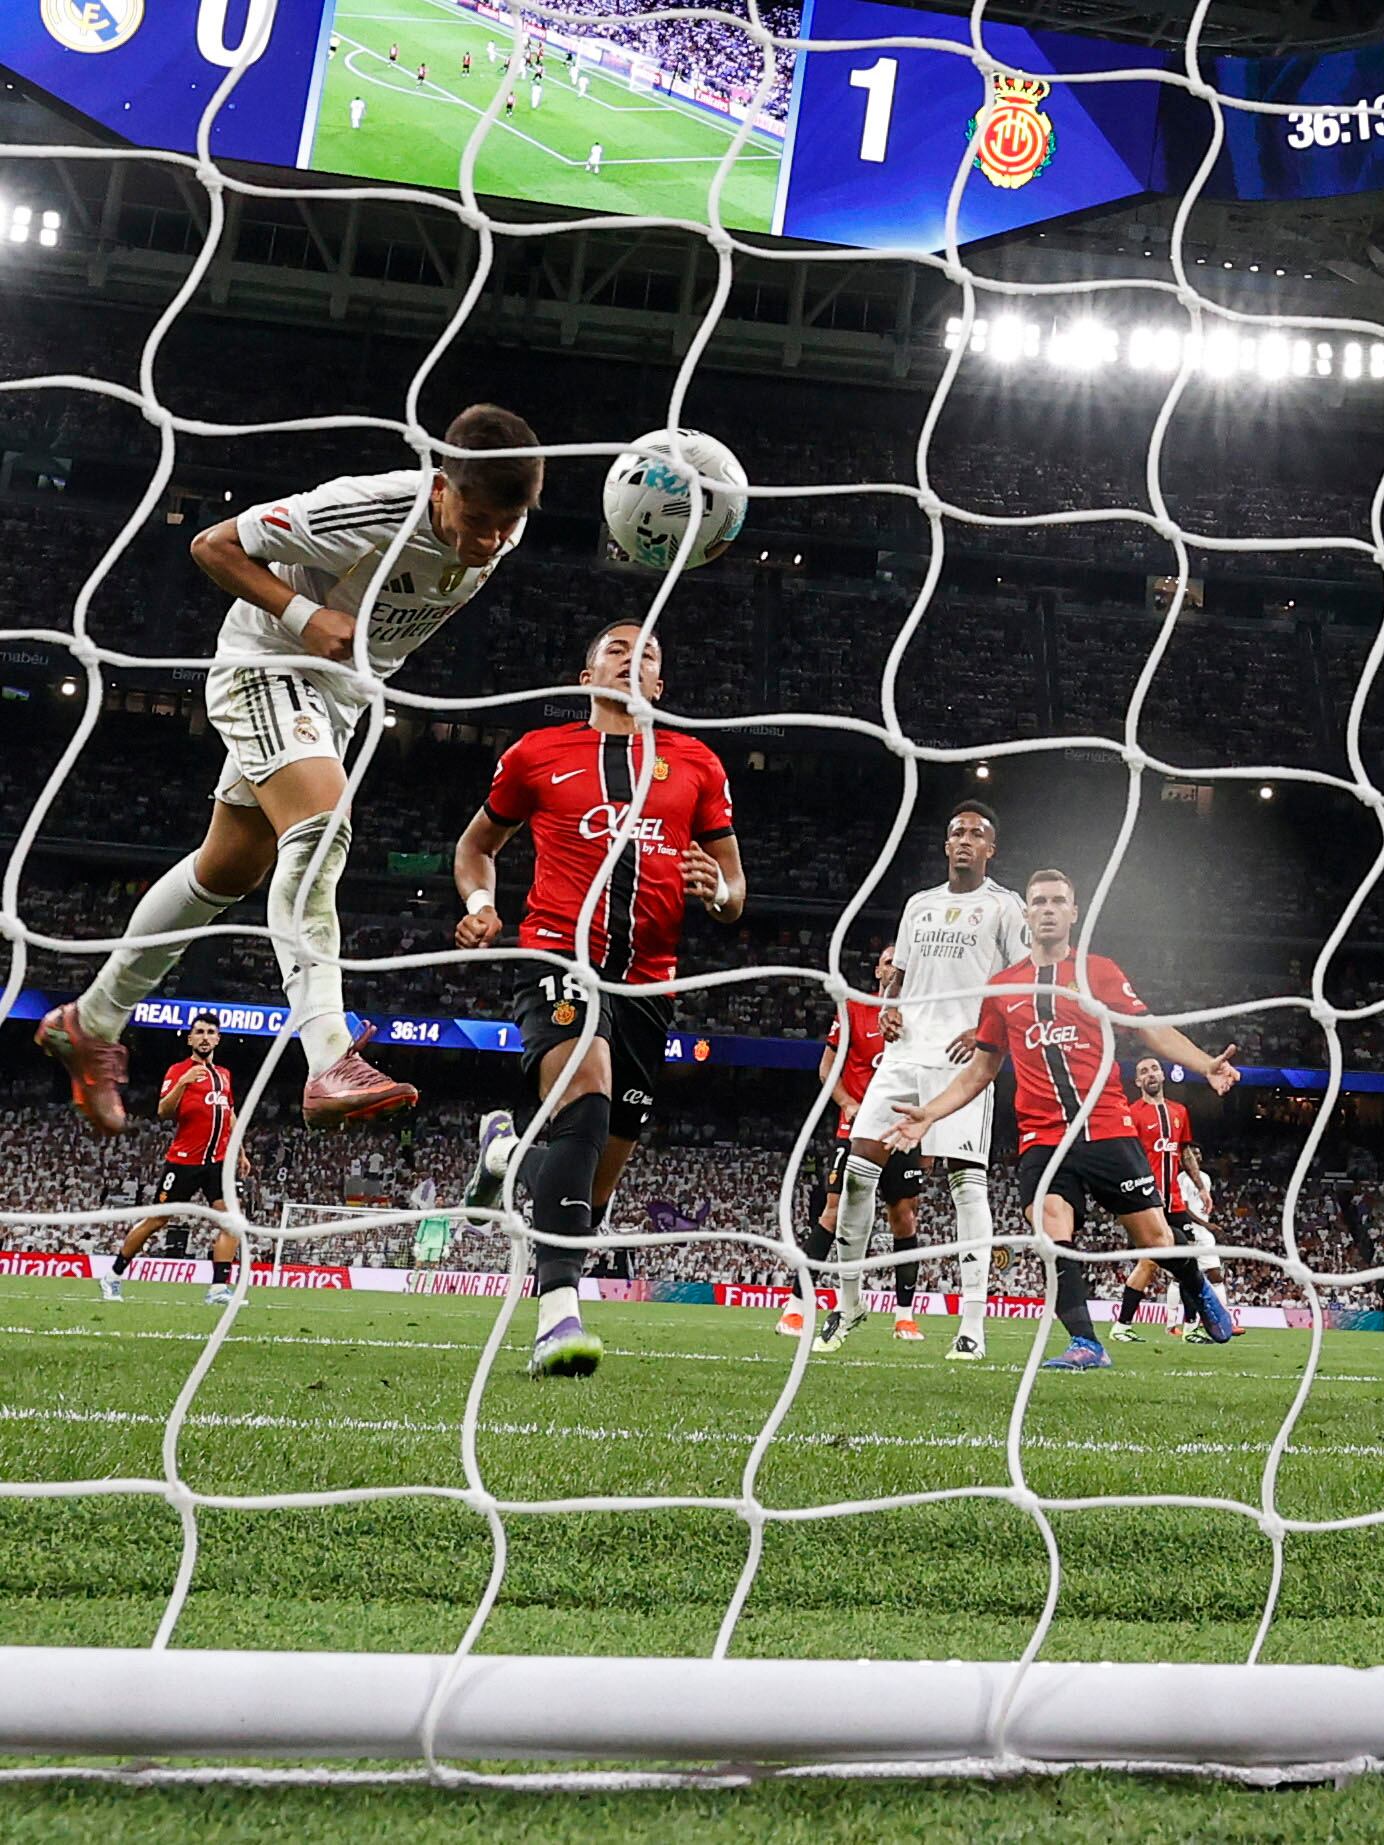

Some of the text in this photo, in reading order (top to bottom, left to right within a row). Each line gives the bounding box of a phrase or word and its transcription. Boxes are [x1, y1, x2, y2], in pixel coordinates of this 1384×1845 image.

[849, 57, 898, 163] 1
[914, 929, 978, 947] Emirates
[134, 1003, 183, 1025] REAL
[188, 1006, 264, 1030] MDRID
[390, 1021, 509, 1048] 36:14 1
[163, 1172, 176, 1191] 8
[0, 1252, 83, 1278] irates
[140, 1261, 197, 1284] BETTER
[725, 1286, 829, 1310] Emirs
[880, 1294, 930, 1314] BEER
